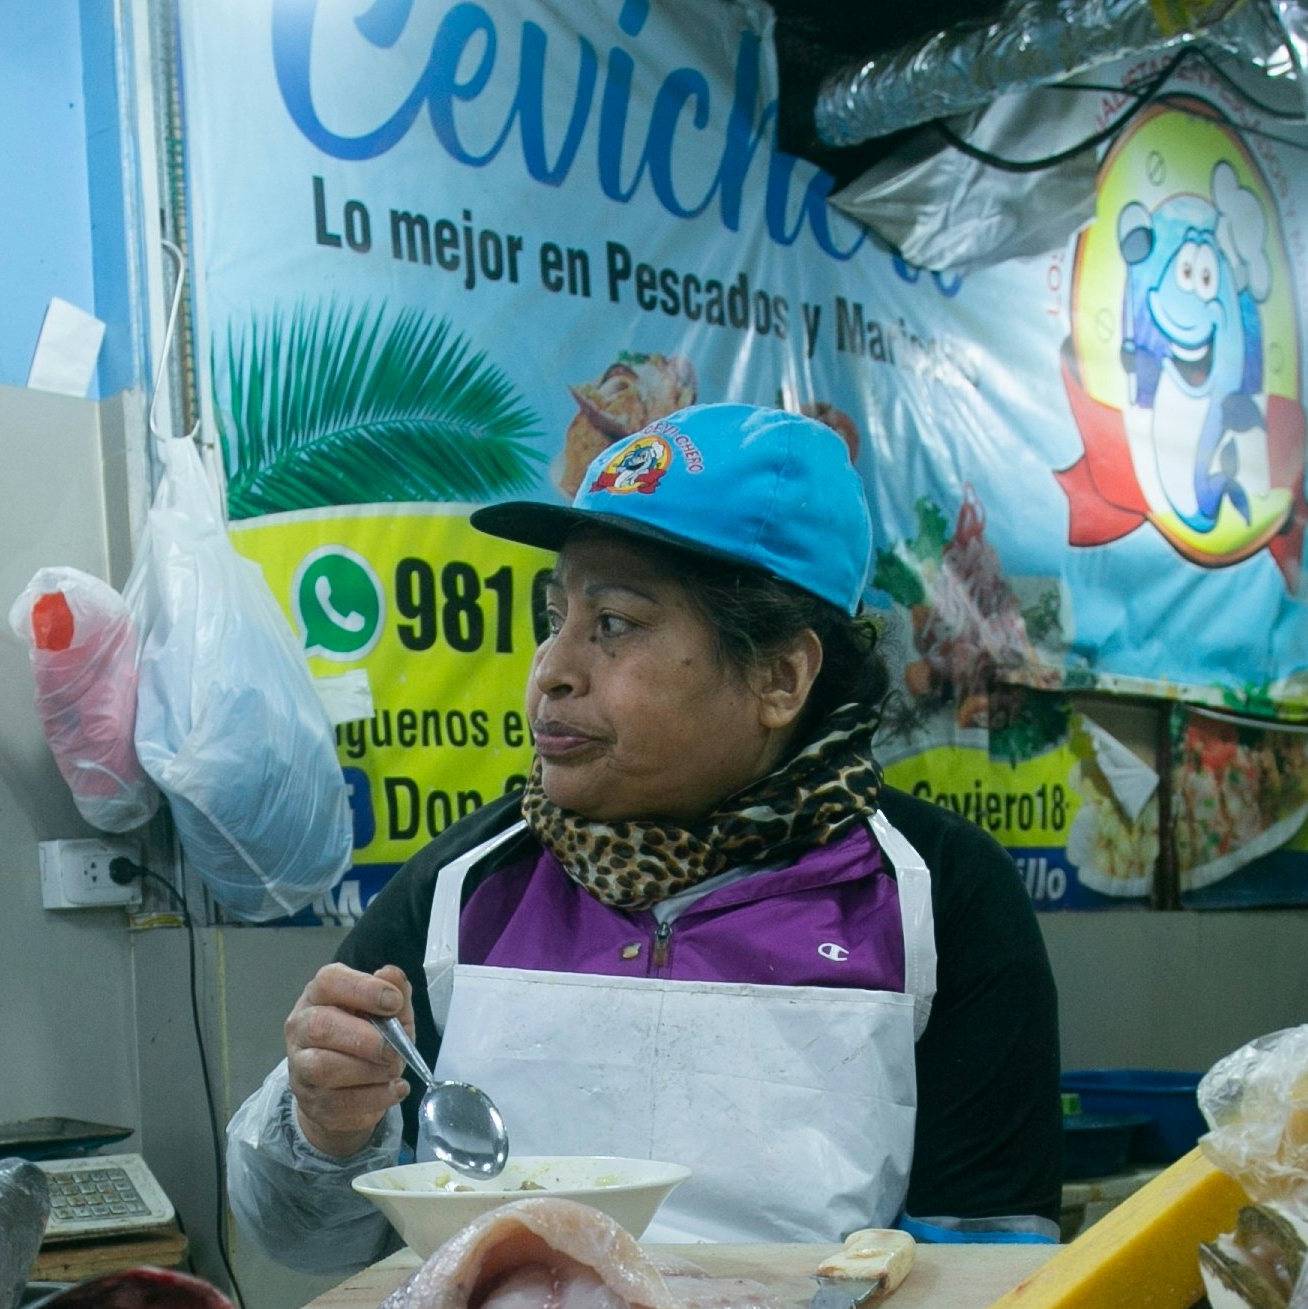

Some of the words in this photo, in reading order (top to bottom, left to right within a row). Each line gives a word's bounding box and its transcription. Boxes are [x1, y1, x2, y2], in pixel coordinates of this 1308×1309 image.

[312, 175, 371, 254] Lo
[389, 208, 523, 290] mejor
[539, 241, 591, 298] en
[606, 240, 789, 340] Pescados
[802, 302, 821, 359] y
[395, 556, 513, 654] 981
